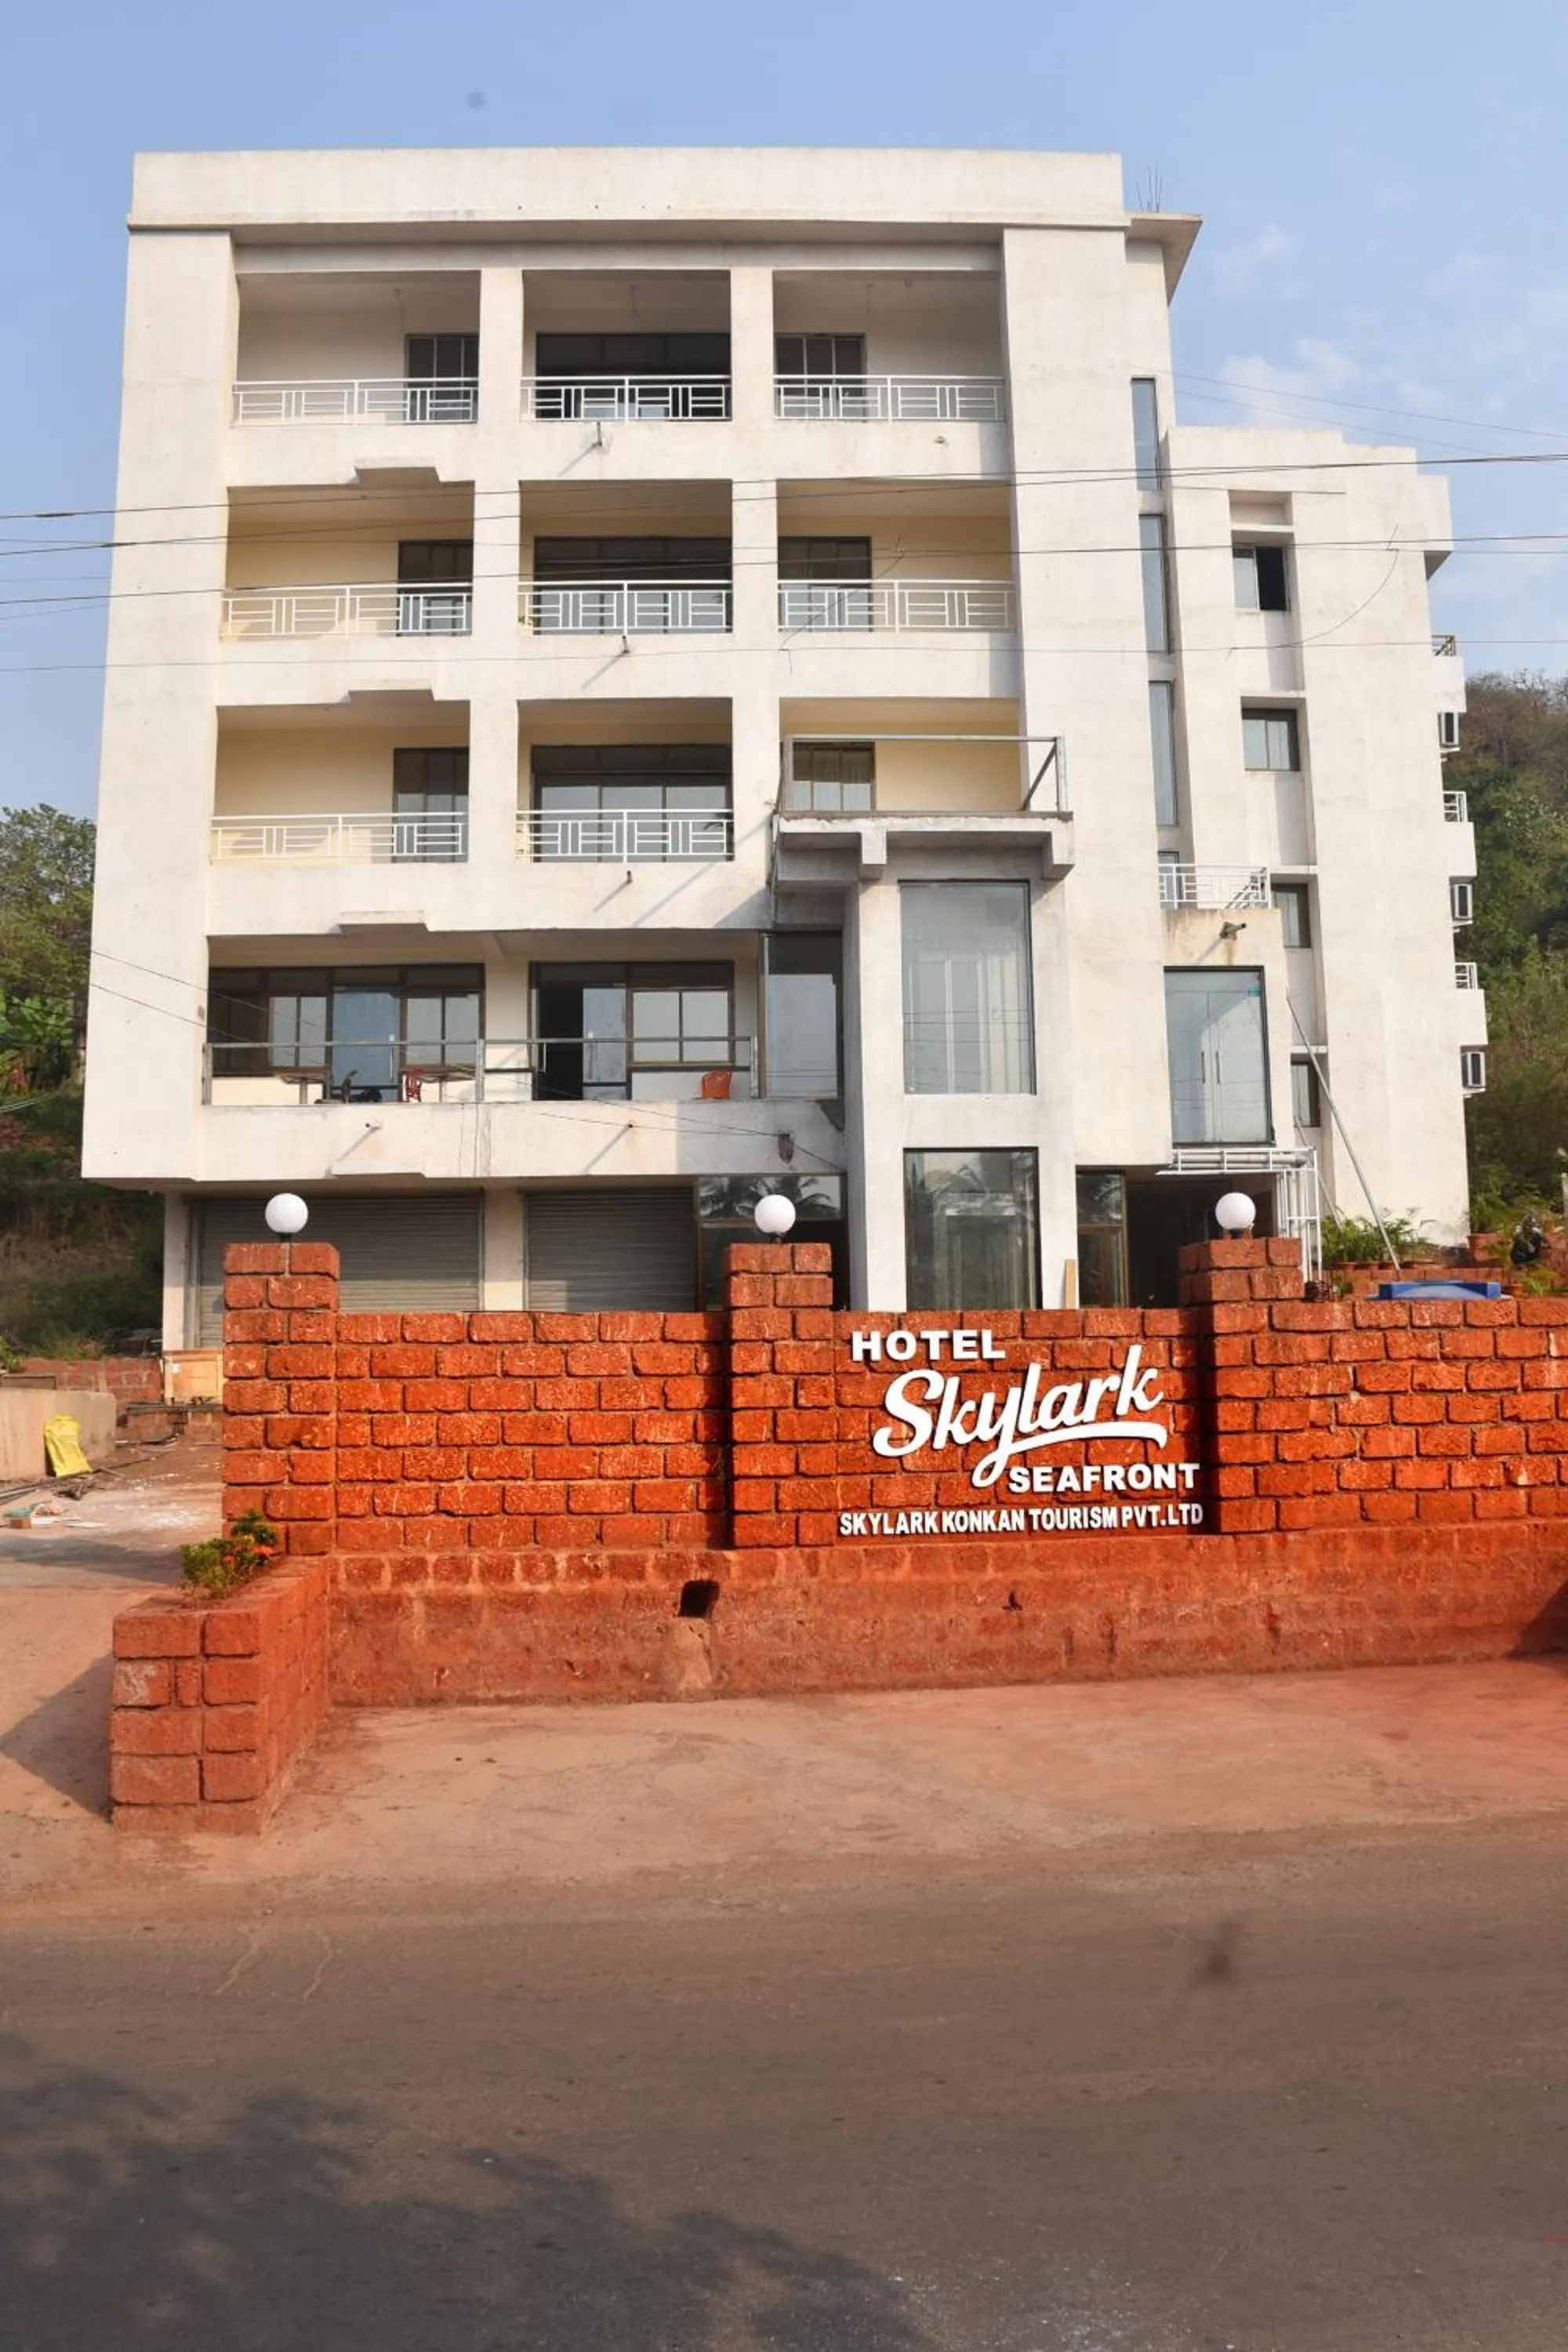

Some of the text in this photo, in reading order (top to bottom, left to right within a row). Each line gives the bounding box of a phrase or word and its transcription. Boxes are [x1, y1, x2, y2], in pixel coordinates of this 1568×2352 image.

[851, 1330, 1006, 1361] HOTEL
[873, 1345, 1167, 1488] Skylark
[1009, 1464, 1200, 1493] SEAFRONT
[840, 1512, 939, 1536] SKYLARK
[942, 1509, 1025, 1533] KONKAN
[1029, 1506, 1117, 1530] TOURISM
